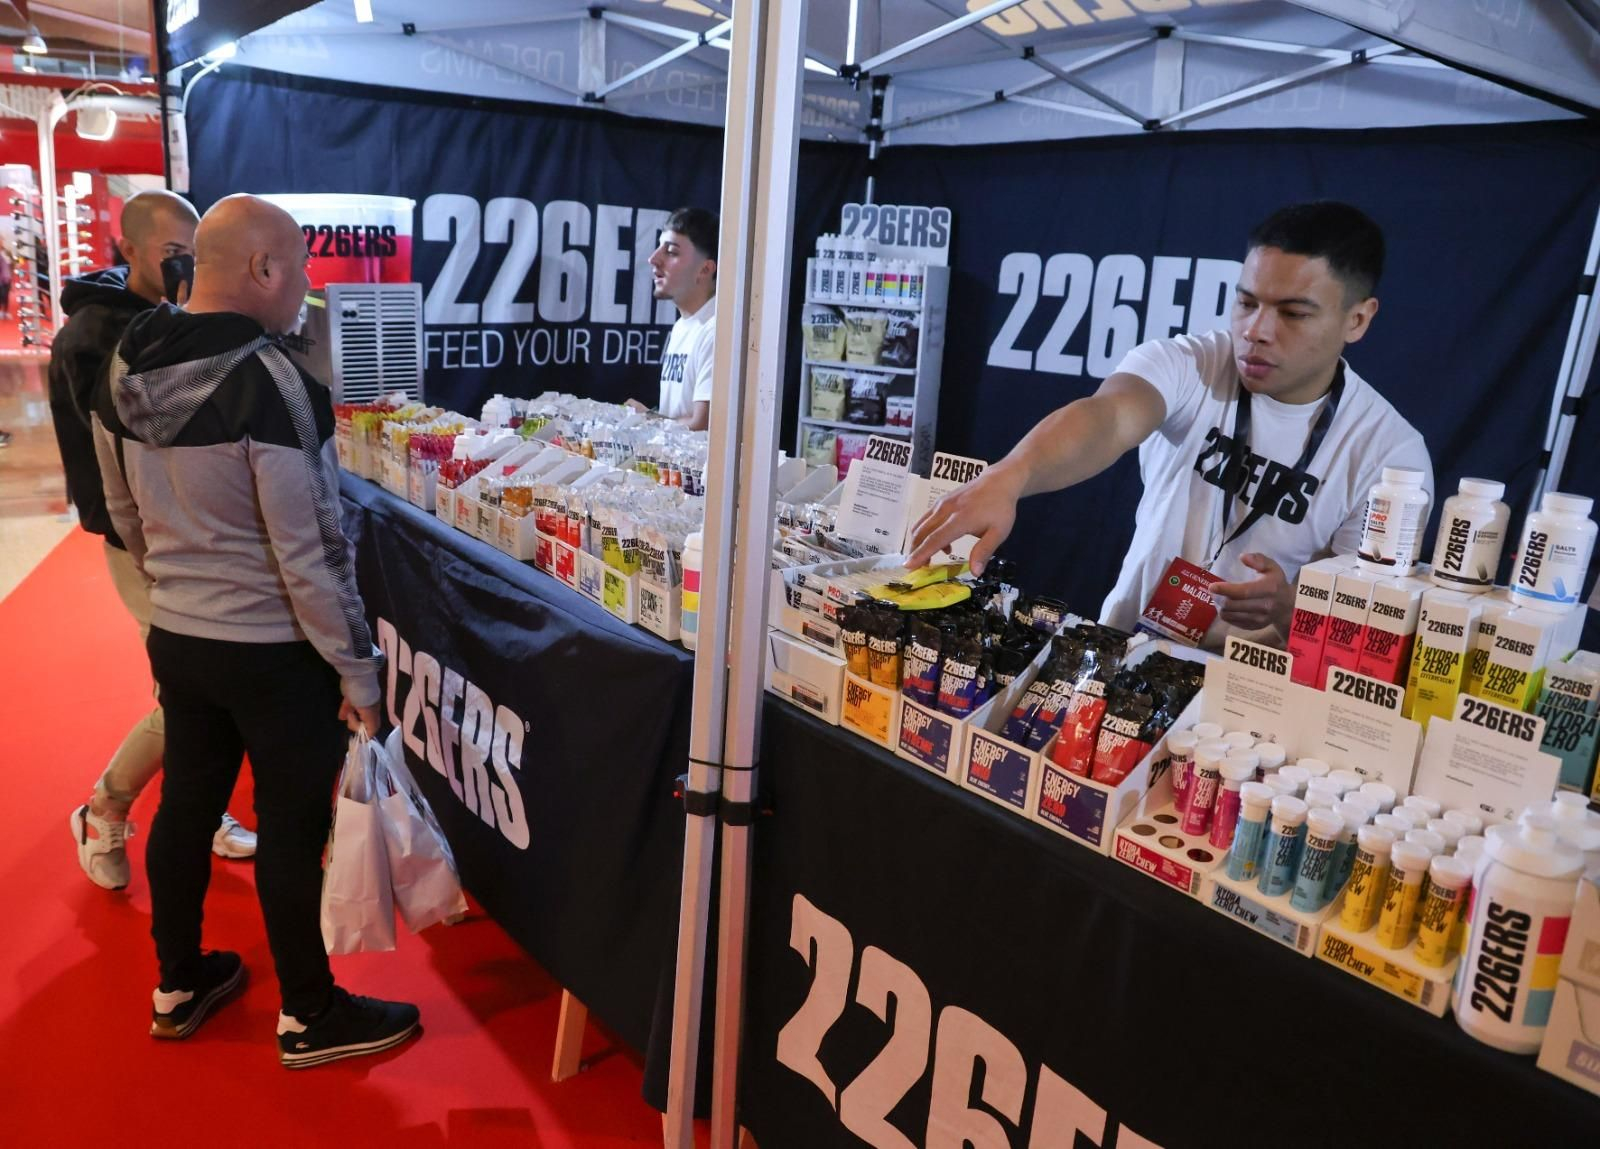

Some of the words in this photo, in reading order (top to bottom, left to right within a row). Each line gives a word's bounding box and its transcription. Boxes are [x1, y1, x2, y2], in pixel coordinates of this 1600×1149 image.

[843, 205, 950, 248] 226ERS
[423, 330, 504, 370] FEED
[513, 328, 591, 368] YOUR
[866, 438, 911, 467] 226ERS
[933, 456, 984, 484] 226ERS
[1371, 511, 1388, 522] PRO
[1443, 518, 1472, 572] 226ERS
[1519, 530, 1549, 588] 226ERS
[828, 586, 841, 599] PRO
[1299, 584, 1329, 601] 226ERS
[1335, 591, 1367, 610] 226ERS
[823, 603, 837, 617] PRO
[1294, 608, 1326, 627] HYDRA
[1372, 601, 1406, 620] 226ERS
[1293, 620, 1318, 637] ZERO
[1331, 616, 1363, 636] HYDRA
[1367, 626, 1400, 646] HYDRA
[1427, 619, 1464, 637] 226ERS
[841, 628, 866, 646] 226ERS
[868, 636, 897, 653] 226ERS
[1328, 629, 1355, 646] ZERO
[1495, 635, 1535, 656] 226ERS
[911, 641, 939, 663] 226ERS
[1229, 641, 1289, 676] 226ERS
[1364, 640, 1392, 656] ZERO
[1423, 646, 1460, 666] HYDRA
[943, 657, 976, 679] 226ERS
[1422, 660, 1451, 677] ZERO
[1488, 662, 1528, 686] HYDRA
[942, 671, 970, 690] ENERGY
[1332, 670, 1399, 710] 226ERS
[1484, 675, 1516, 695] ZERO
[1545, 690, 1589, 714] HYDRA
[903, 717, 921, 736] SHOT
[904, 704, 933, 730] ENERGY
[1101, 712, 1140, 737] 226ERS
[1460, 698, 1538, 742] 226ERS
[1538, 704, 1598, 737] HYDRA
[1098, 727, 1131, 748] ENERGY
[1541, 724, 1581, 752] ERO
[971, 750, 994, 770] SHOT
[973, 737, 1009, 763] ENERGY
[1043, 781, 1065, 804] SHOT
[1045, 769, 1081, 799] ENERGY
[1281, 825, 1297, 836] 226
[1119, 838, 1141, 855] HYDRA
[1308, 834, 1336, 849] 226ERS
[1118, 848, 1136, 863] ZERO
[1135, 856, 1158, 873] CHEW
[1300, 865, 1325, 881] CHEW
[1216, 886, 1241, 905] HYDRA
[1214, 895, 1234, 912] ZERO
[1234, 905, 1259, 924] CHEW
[1325, 935, 1355, 956] HYDRA
[1323, 945, 1347, 963] ZERO
[1346, 956, 1375, 977] CHEW
[1470, 901, 1532, 1023] 226ERS
